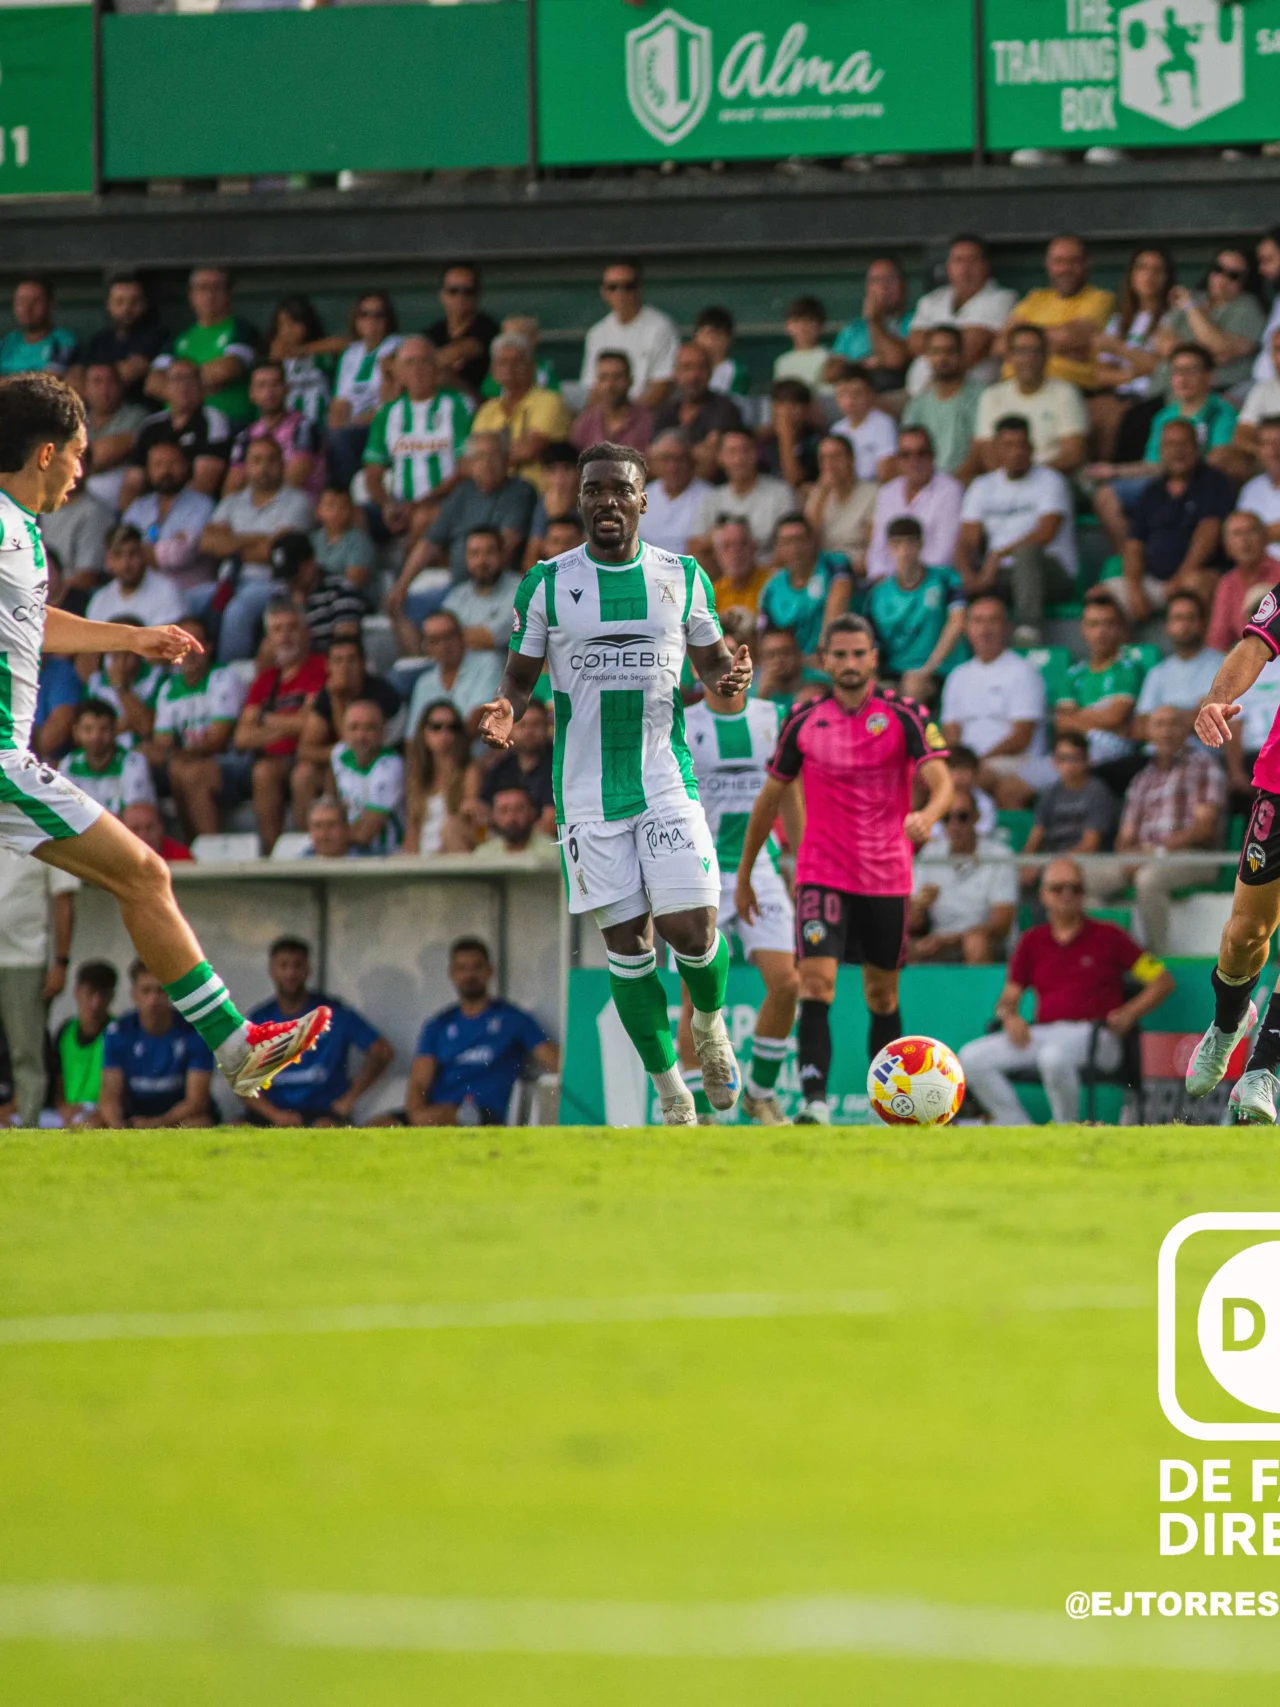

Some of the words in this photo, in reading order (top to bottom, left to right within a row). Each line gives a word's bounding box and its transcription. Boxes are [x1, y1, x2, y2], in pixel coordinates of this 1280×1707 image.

[718, 22, 885, 100] Alma
[990, 38, 1116, 86] TRAINING
[1060, 86, 1117, 132] BOX
[570, 652, 669, 669] COHEBU
[618, 672, 628, 681] de
[701, 776, 762, 791] COHEB
[1253, 799, 1275, 842] 9
[802, 889, 842, 924] 20
